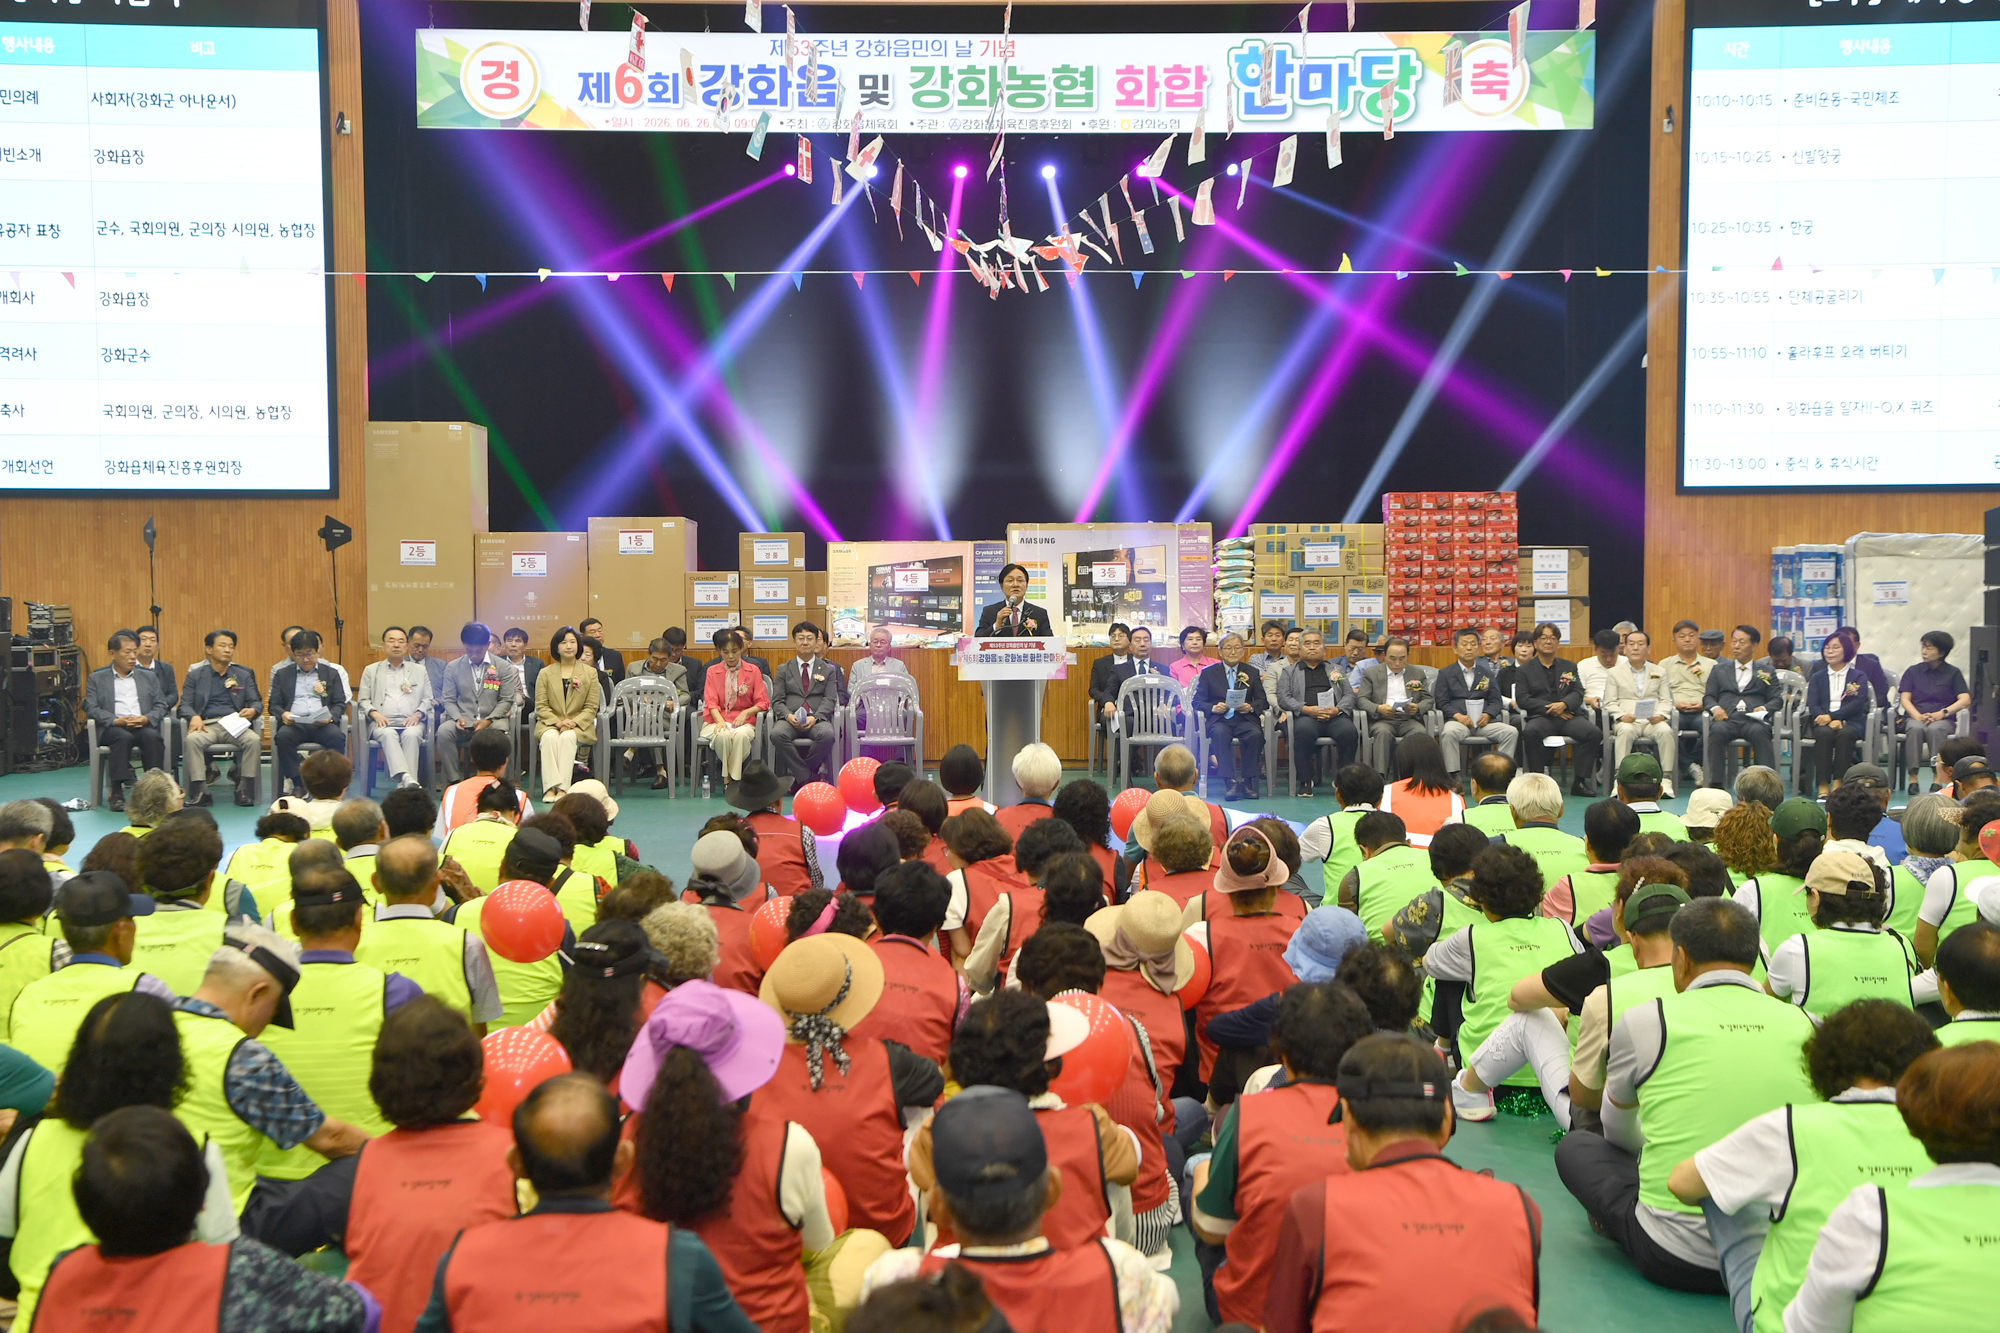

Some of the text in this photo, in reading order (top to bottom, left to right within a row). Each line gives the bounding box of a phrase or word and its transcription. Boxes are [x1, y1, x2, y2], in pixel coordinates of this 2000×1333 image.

[189, 40, 217, 57] 비고
[770, 39, 1015, 58] 제53주년 강화읍민의 날 기념
[1722, 37, 1892, 59] 시간 행사내용
[480, 60, 520, 100] 경
[577, 44, 1419, 118] 제6회 강화읍 및 강화농협 화합 한마당
[1470, 59, 1510, 101] 축
[91, 91, 175, 109] 사회자(강화군
[179, 93, 237, 110] 아나운서)
[1696, 93, 1773, 108] 10:10~10:15
[611, 117, 633, 129] 일시
[644, 117, 673, 129] 2026.
[677, 117, 693, 129] 06.
[786, 118, 898, 130] 주최 강화체육회
[916, 118, 938, 130] 주관
[1088, 118, 1110, 130] 후원
[0, 147, 145, 166] 빈소개 강화읍장
[1694, 150, 1772, 164] 10:15~10:25
[36, 223, 61, 240] 표창
[96, 220, 124, 236] 군수,
[129, 220, 184, 237] 국회의원,
[189, 221, 227, 238] 군의장
[231, 222, 274, 238] 시의원,
[278, 222, 316, 239] 농협장
[1691, 222, 1773, 235] 10:25~10:35
[99, 291, 150, 308] 강화읍장
[1690, 291, 1770, 304] 10:35~10:55
[101, 347, 151, 363] 강화군수
[1692, 346, 1767, 360] 10:55~11:10
[1840, 345, 1864, 359] 오래
[1869, 344, 1907, 359] 버티기
[0, 403, 292, 421] 축사 국회의원, 군의장, 시의원, 농협장
[1692, 402, 1765, 415] 11:10~11:30
[1786, 401, 1835, 417] 강화읍을
[1909, 400, 1934, 414] 퀴즈
[2, 459, 242, 476] 개회선언 강화읍체육진흥후원회장
[1688, 456, 1879, 472] 11:30~13:00 중식 & 휴식시간
[628, 535, 644, 546] 1등
[1018, 537, 1056, 545] AMSUNG
[408, 545, 426, 557] 2등
[520, 557, 537, 569] 5등
[902, 573, 919, 583] 4등
[1100, 568, 1117, 578] 3등
